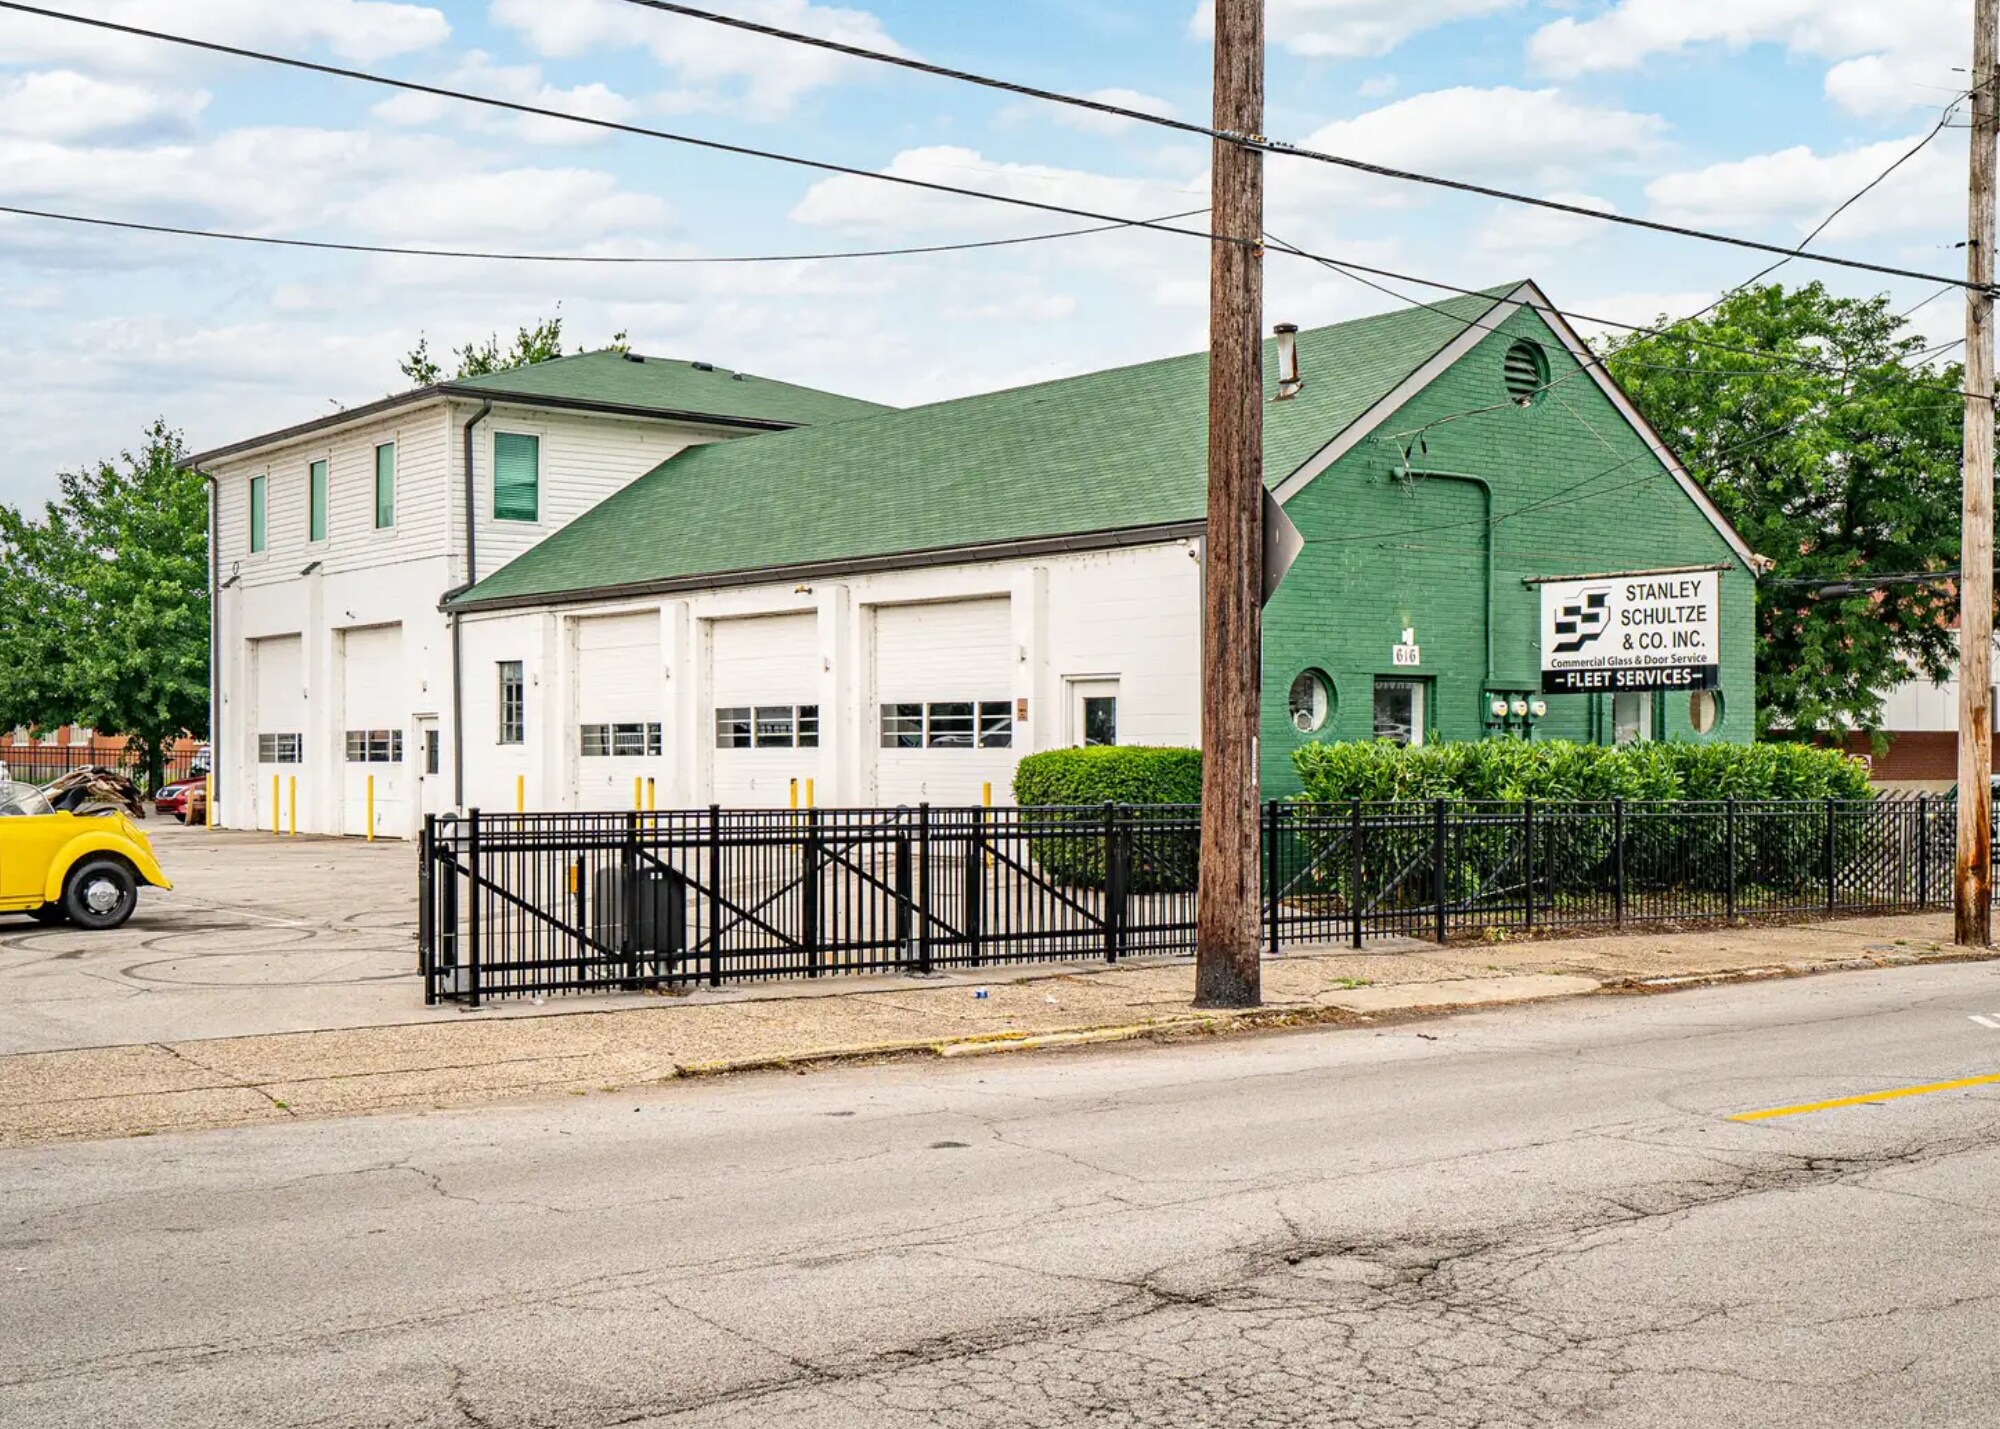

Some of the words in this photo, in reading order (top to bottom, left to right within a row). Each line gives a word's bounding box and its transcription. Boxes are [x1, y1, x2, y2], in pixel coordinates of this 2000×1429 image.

[1626, 580, 1701, 601] STANLEY
[1621, 605, 1707, 626] SCHULTZE
[1623, 633, 1634, 650] &
[1639, 631, 1667, 649] CO.
[1673, 630, 1705, 648] INC.
[1396, 648, 1416, 662] 616
[1551, 656, 1605, 668] Commercial
[1607, 656, 1633, 666] Glass
[1634, 655, 1642, 665] &
[1644, 655, 1668, 664] Door
[1670, 652, 1707, 664] Service
